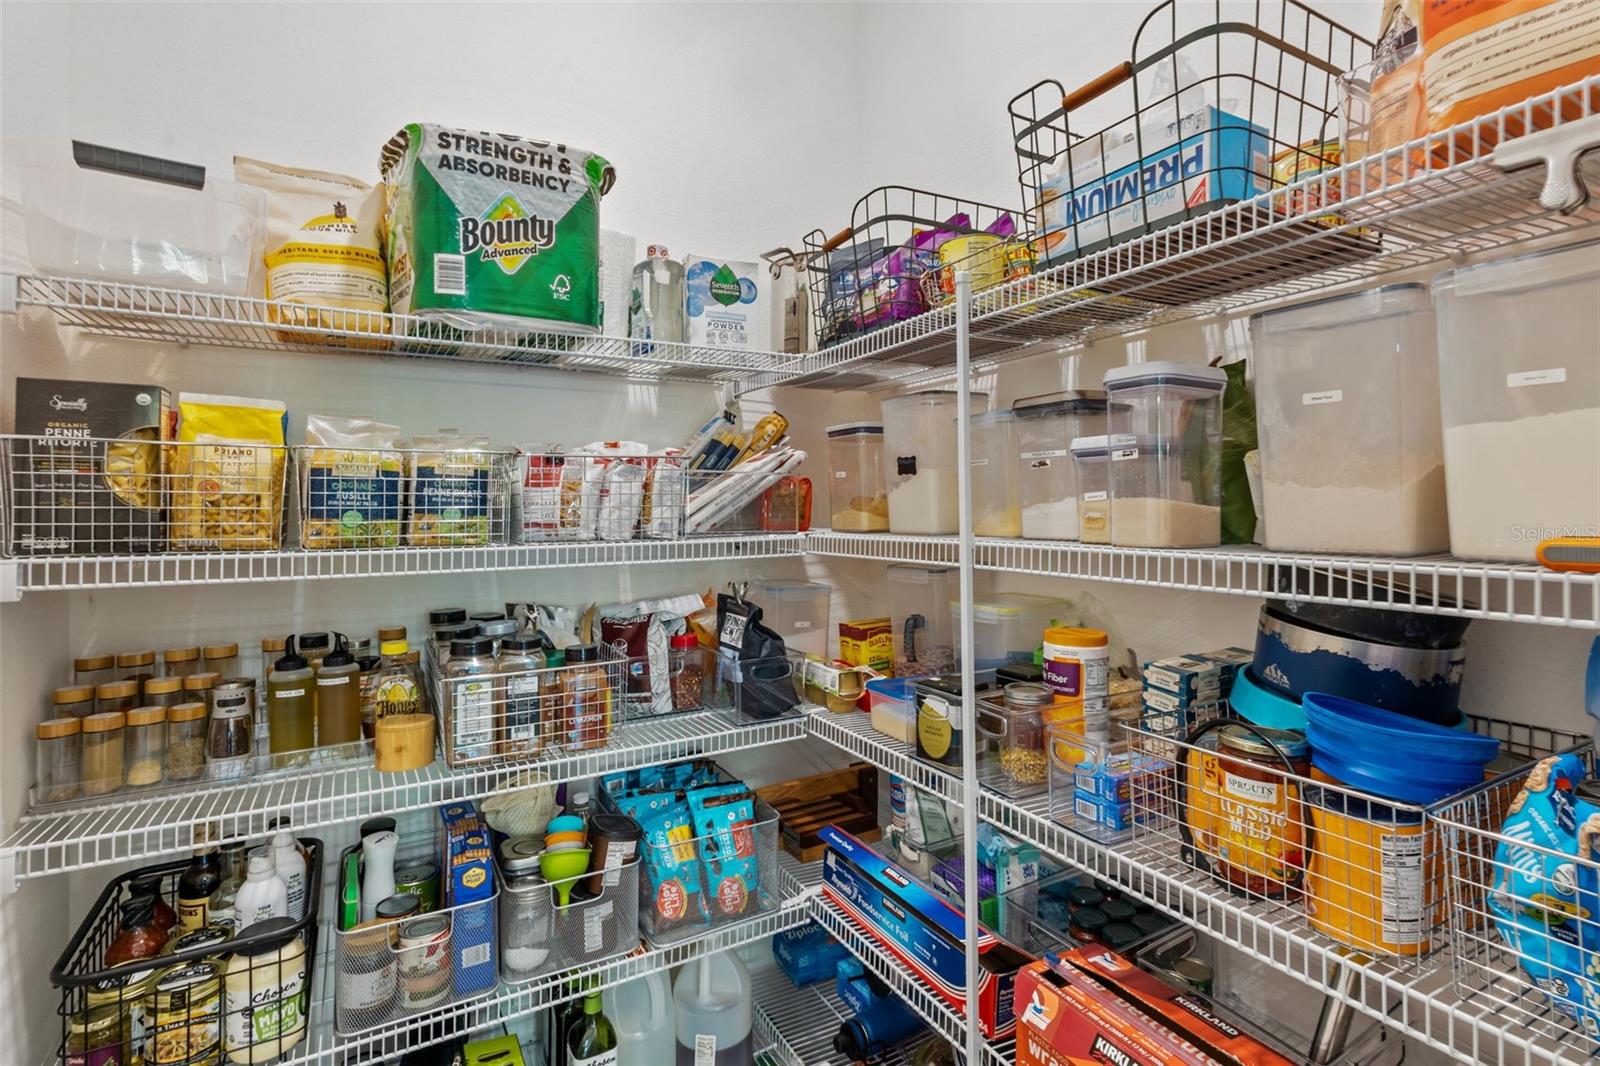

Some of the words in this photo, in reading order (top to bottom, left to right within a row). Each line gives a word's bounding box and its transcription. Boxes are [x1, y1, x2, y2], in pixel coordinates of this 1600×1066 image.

[438, 131, 553, 171] STRENGTH
[558, 157, 572, 175] &
[438, 154, 570, 193] ABSORBENCY
[1066, 143, 1204, 226] PREMIUM
[461, 214, 554, 253] Bounty
[482, 244, 538, 260] Advanced
[711, 281, 739, 290] Seventh
[707, 321, 745, 331] POWDER
[45, 428, 91, 437] PENNE
[214, 446, 253, 456] PRIANO
[1047, 671, 1068, 683] Fiber
[376, 700, 417, 718] Honey
[1229, 776, 1274, 795] SPROUTS
[1528, 807, 1552, 836] ORGANIC
[662, 882, 674, 917] Enjoy
[670, 885, 681, 908] Life
[723, 879, 734, 913] Enjoy
[731, 883, 741, 905] Life
[858, 894, 895, 932] Foodservice
[895, 924, 909, 942] Foil
[785, 923, 821, 940] Ziploc
[252, 981, 298, 1003] Chosen
[259, 1001, 296, 1028] MAYO
[1174, 995, 1240, 1037] KIRKLAND
[1028, 1039, 1063, 1066] wra
